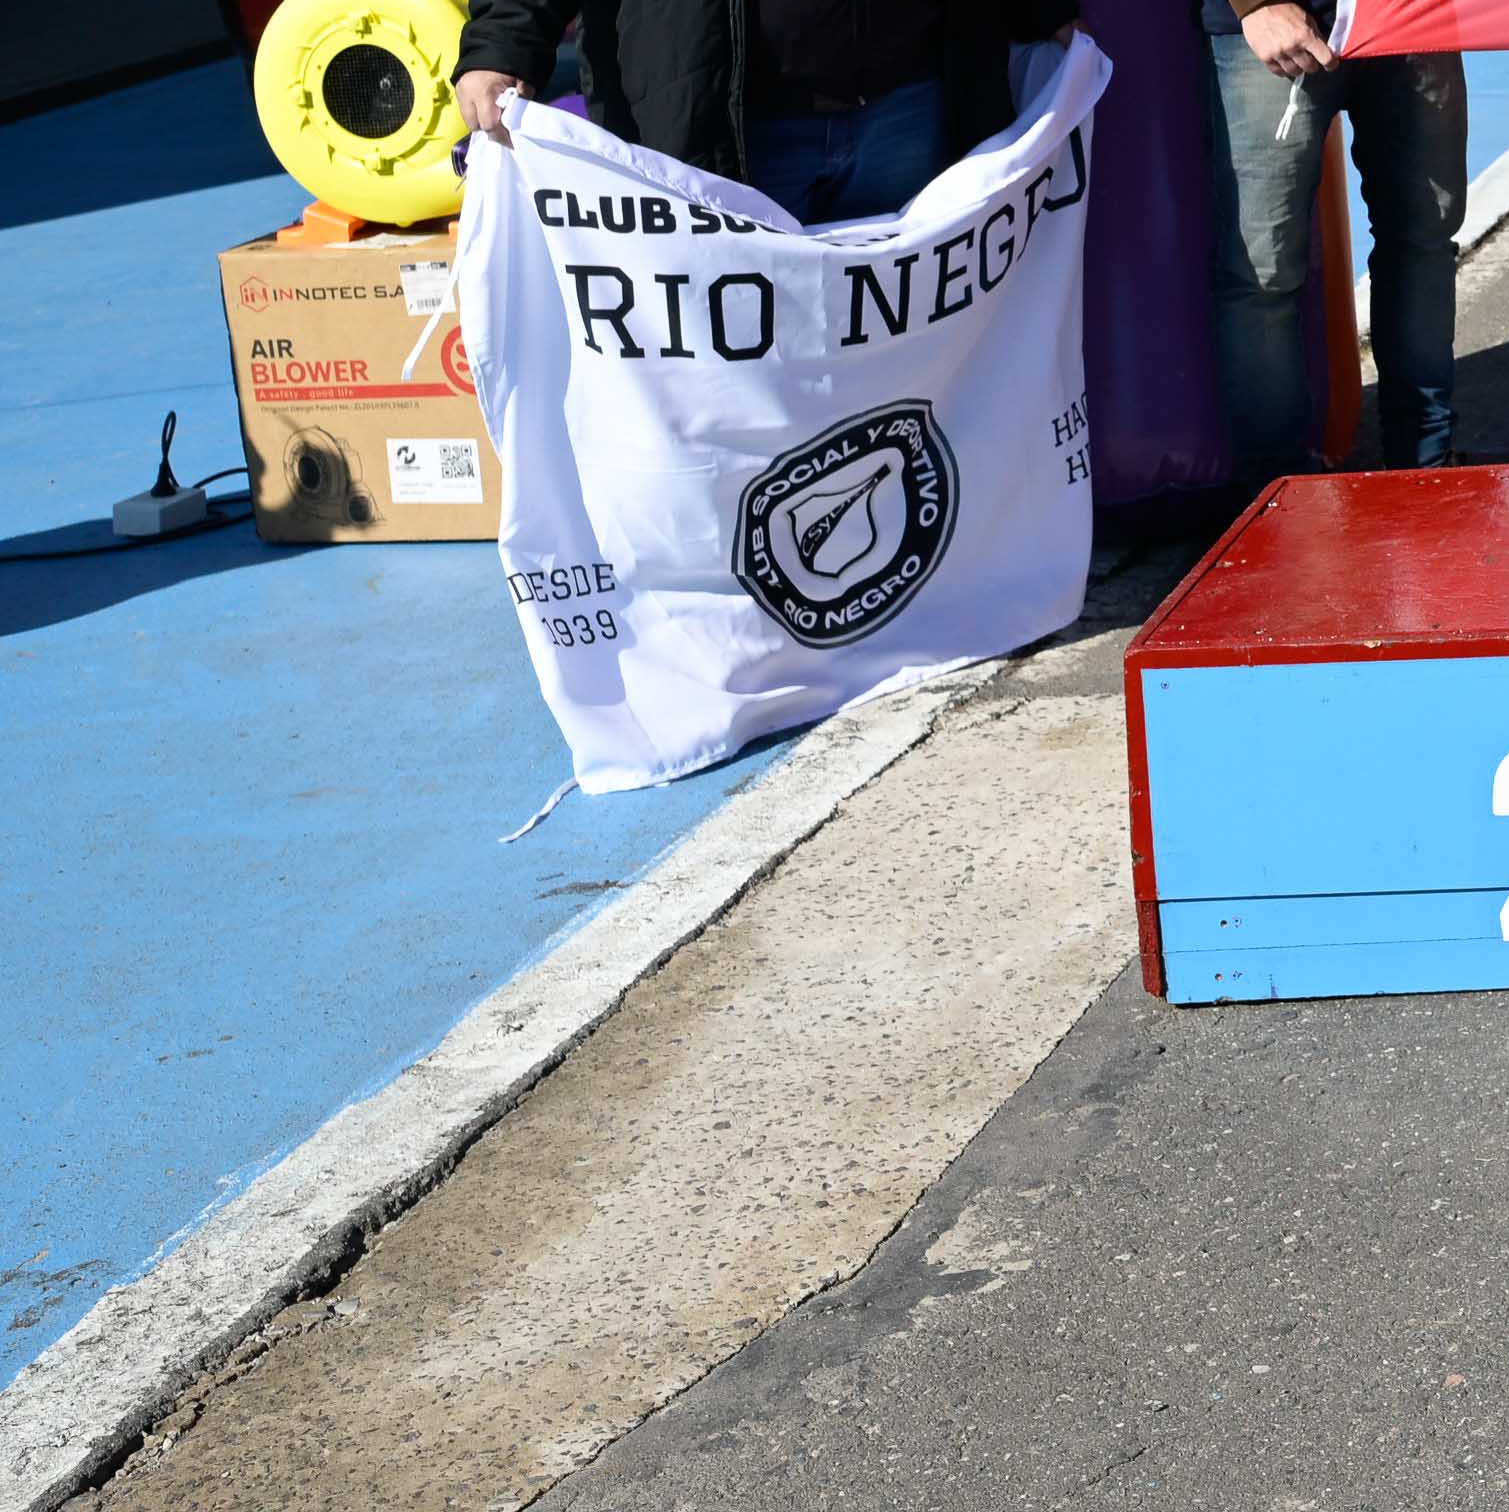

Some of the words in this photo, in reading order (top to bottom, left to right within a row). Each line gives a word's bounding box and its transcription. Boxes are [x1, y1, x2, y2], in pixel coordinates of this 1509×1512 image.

[533, 188, 676, 235] CLUB
[273, 286, 367, 301] INNOTEC
[565, 264, 774, 361] RIO
[251, 339, 295, 359] AIR
[251, 359, 369, 384] BLOWER
[753, 439, 859, 516] SOCIAL
[507, 563, 616, 604] DESDE
[824, 554, 921, 629] NEGRO
[541, 609, 618, 647] 1939
